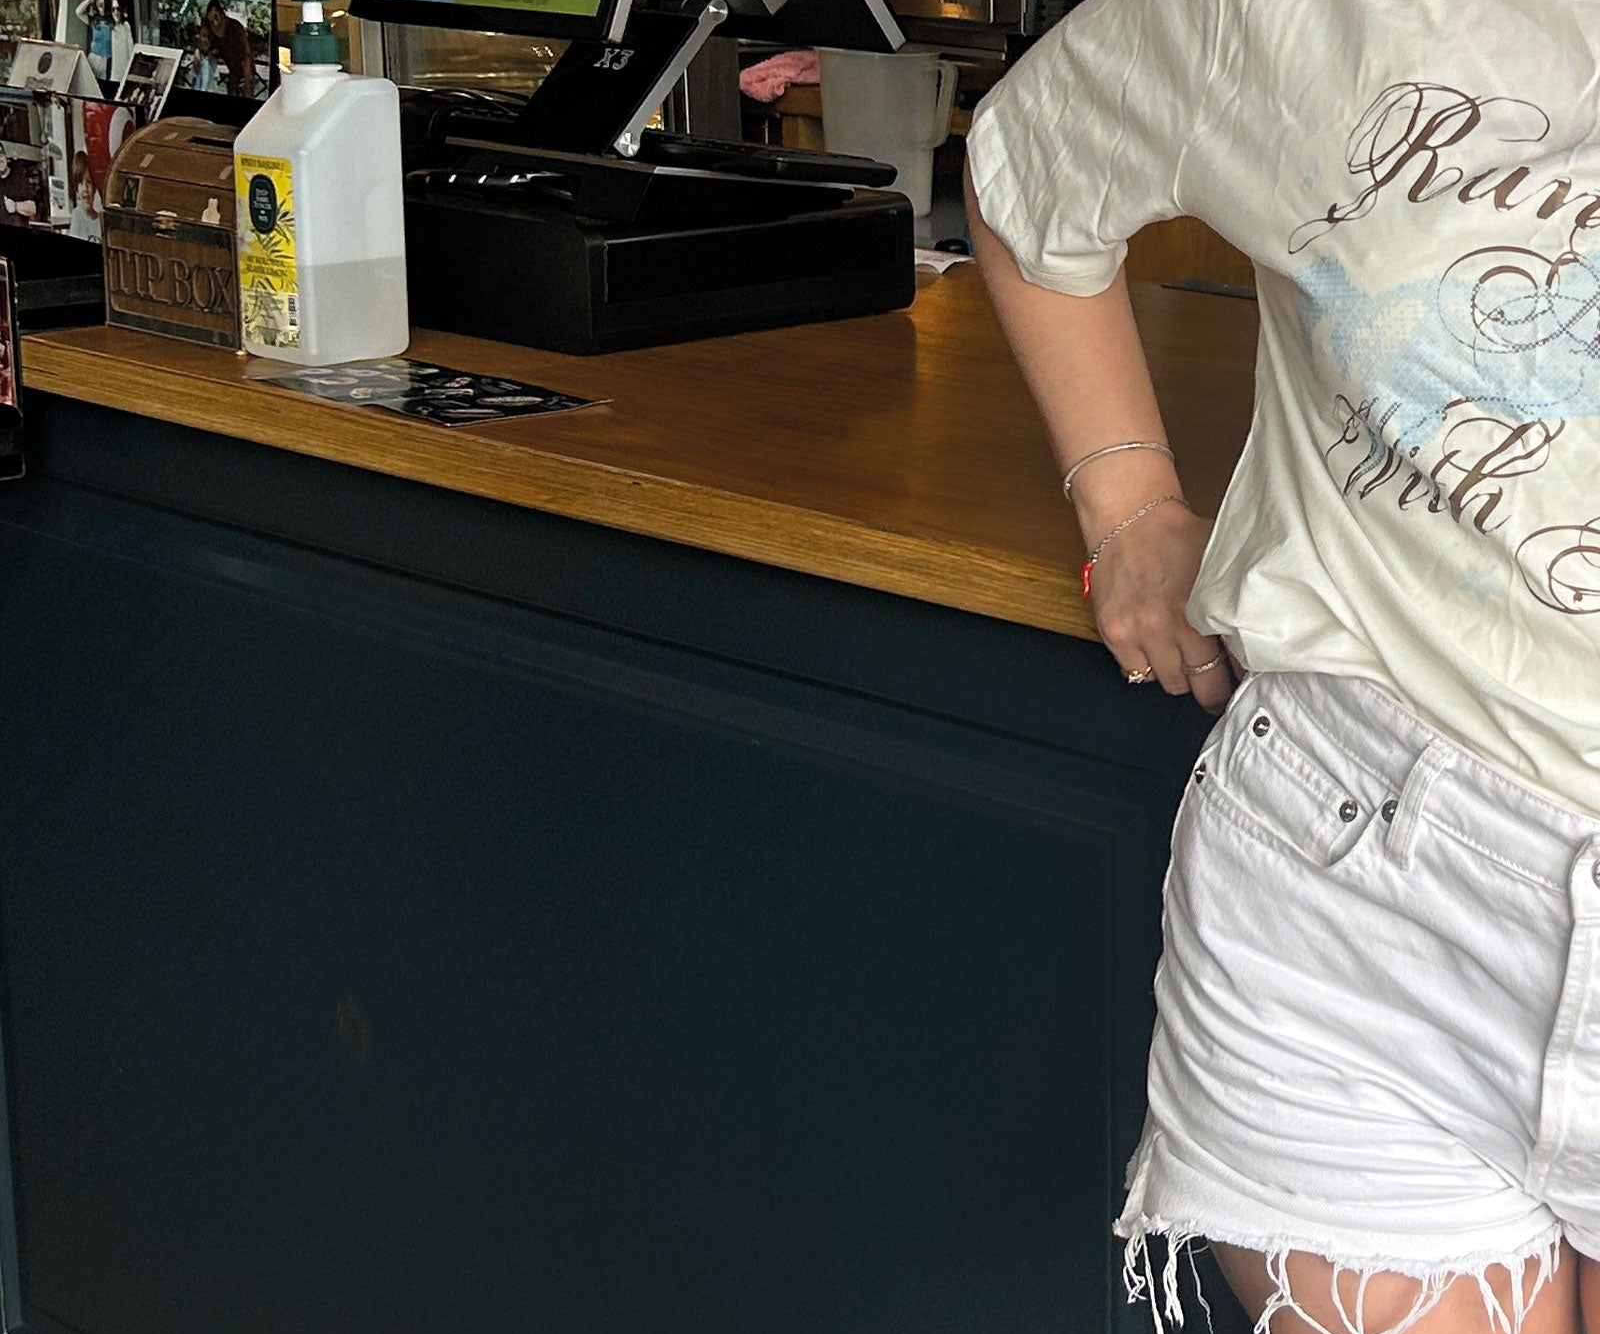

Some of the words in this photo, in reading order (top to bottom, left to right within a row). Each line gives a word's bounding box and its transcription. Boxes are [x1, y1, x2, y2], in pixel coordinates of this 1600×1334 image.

[108, 247, 166, 302] TIP
[169, 258, 235, 314] BOX
[1325, 391, 1564, 537] With
